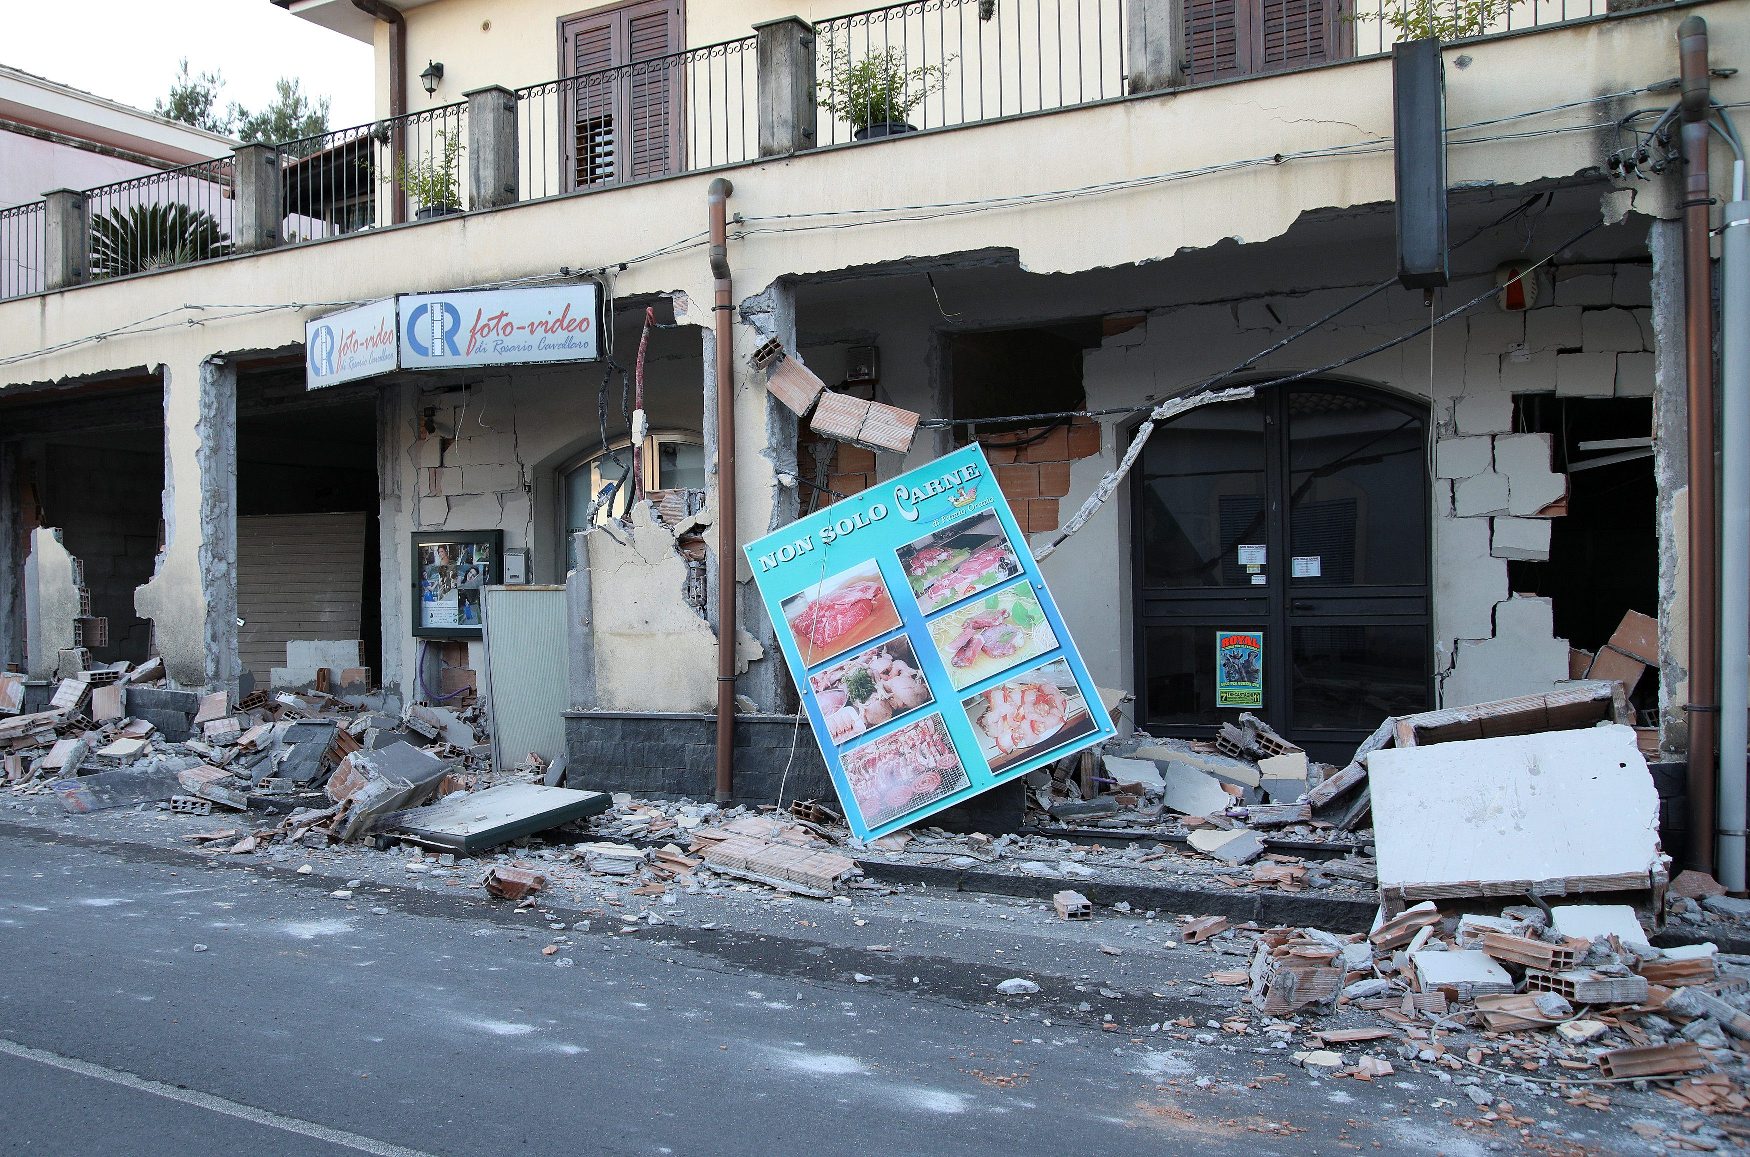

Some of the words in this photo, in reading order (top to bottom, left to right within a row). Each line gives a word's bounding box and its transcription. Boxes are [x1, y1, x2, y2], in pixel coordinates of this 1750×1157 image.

[336, 316, 394, 374] foto-video
[466, 303, 590, 357] foto-video
[475, 340, 488, 354] di
[493, 339, 533, 355] Rosario
[538, 335, 589, 351] Cavallaro
[758, 535, 815, 573] NON
[818, 503, 889, 544] SOLO
[893, 463, 982, 522] CARNE
[1222, 635, 1260, 649] ROYAL
